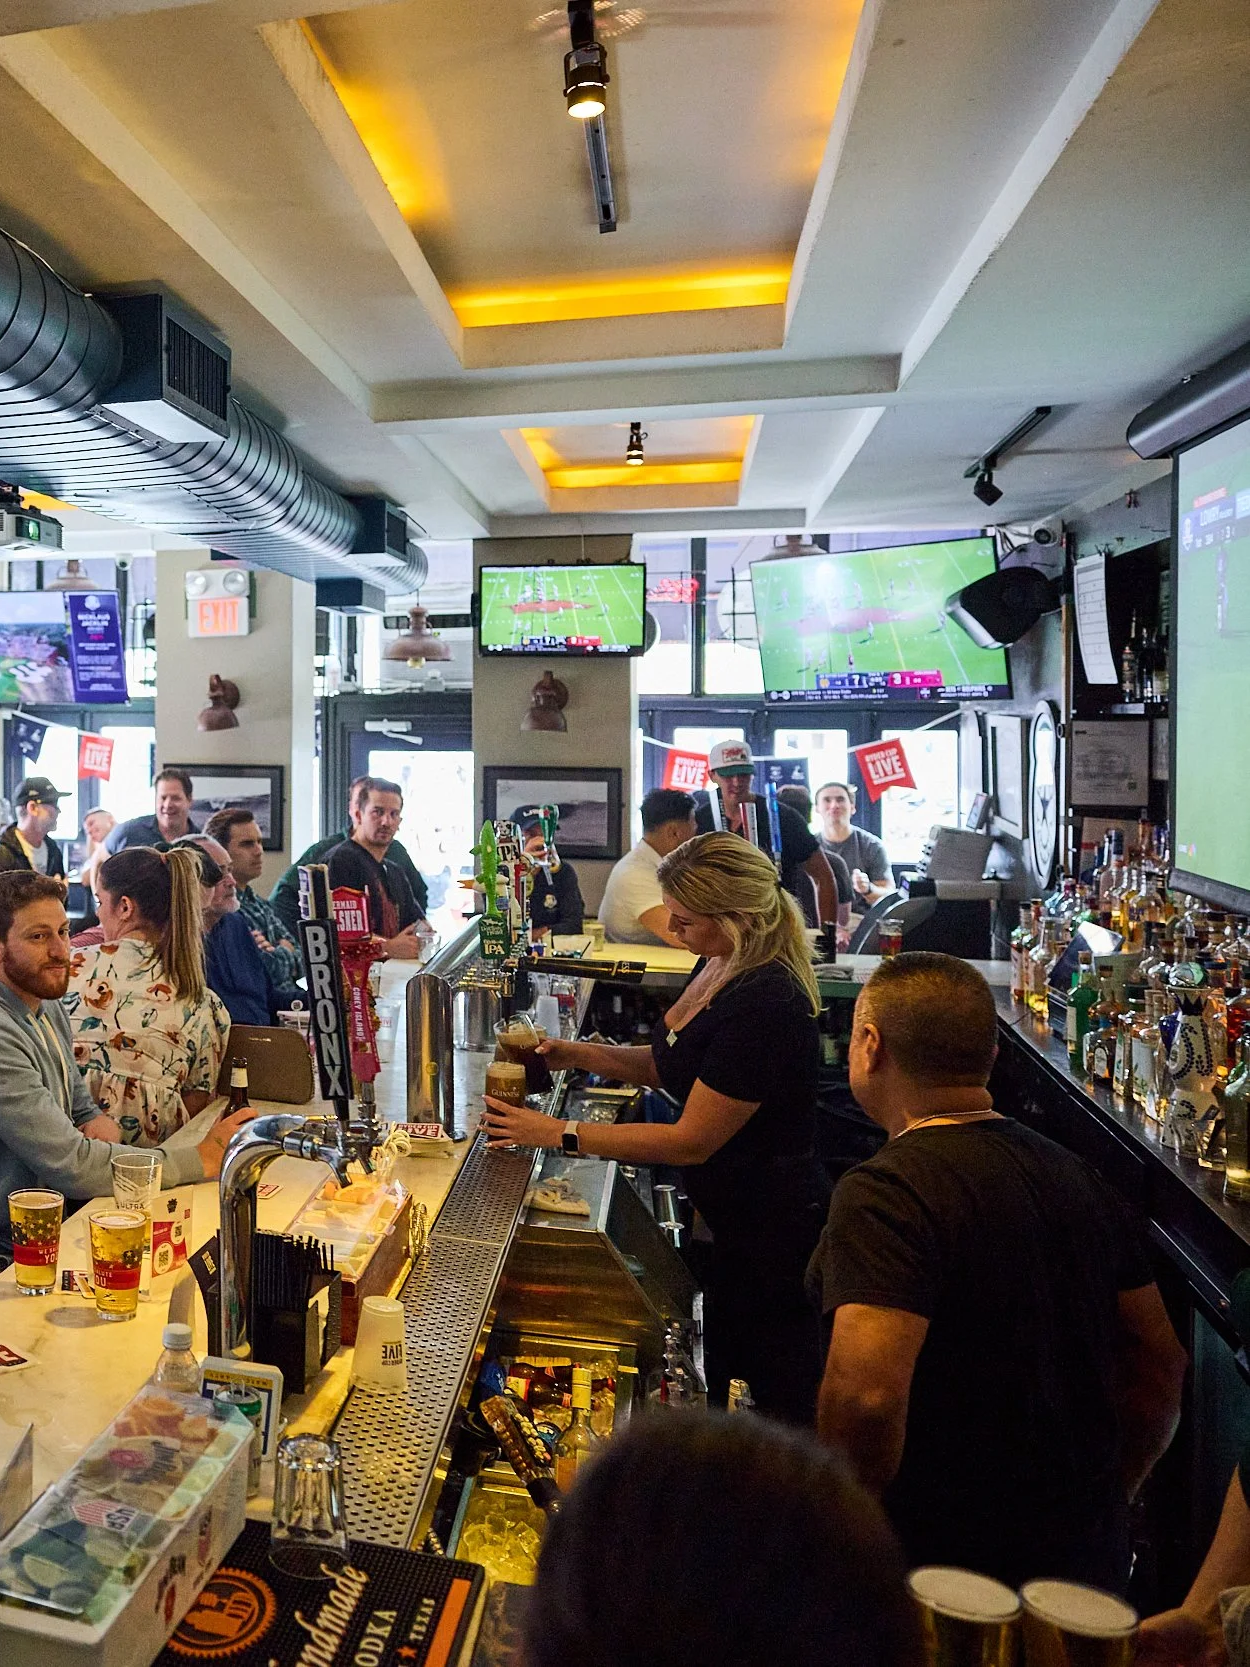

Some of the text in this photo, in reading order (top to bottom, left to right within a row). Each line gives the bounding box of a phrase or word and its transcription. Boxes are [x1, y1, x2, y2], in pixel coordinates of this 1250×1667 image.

[198, 600, 238, 633] EXIT
[85, 748, 110, 768] LIVE
[867, 755, 905, 780] LIVE
[672, 764, 706, 787] LIVE
[332, 900, 356, 910] ERMAID
[484, 944, 506, 955] IPA
[304, 925, 345, 1097] BRONX
[352, 987, 362, 1012] CONEY
[491, 1088, 520, 1098] GUINNESS
[381, 1344, 402, 1359] LIVE
[409, 1597, 436, 1641] TEXAS
[354, 1609, 398, 1667] ODKA
